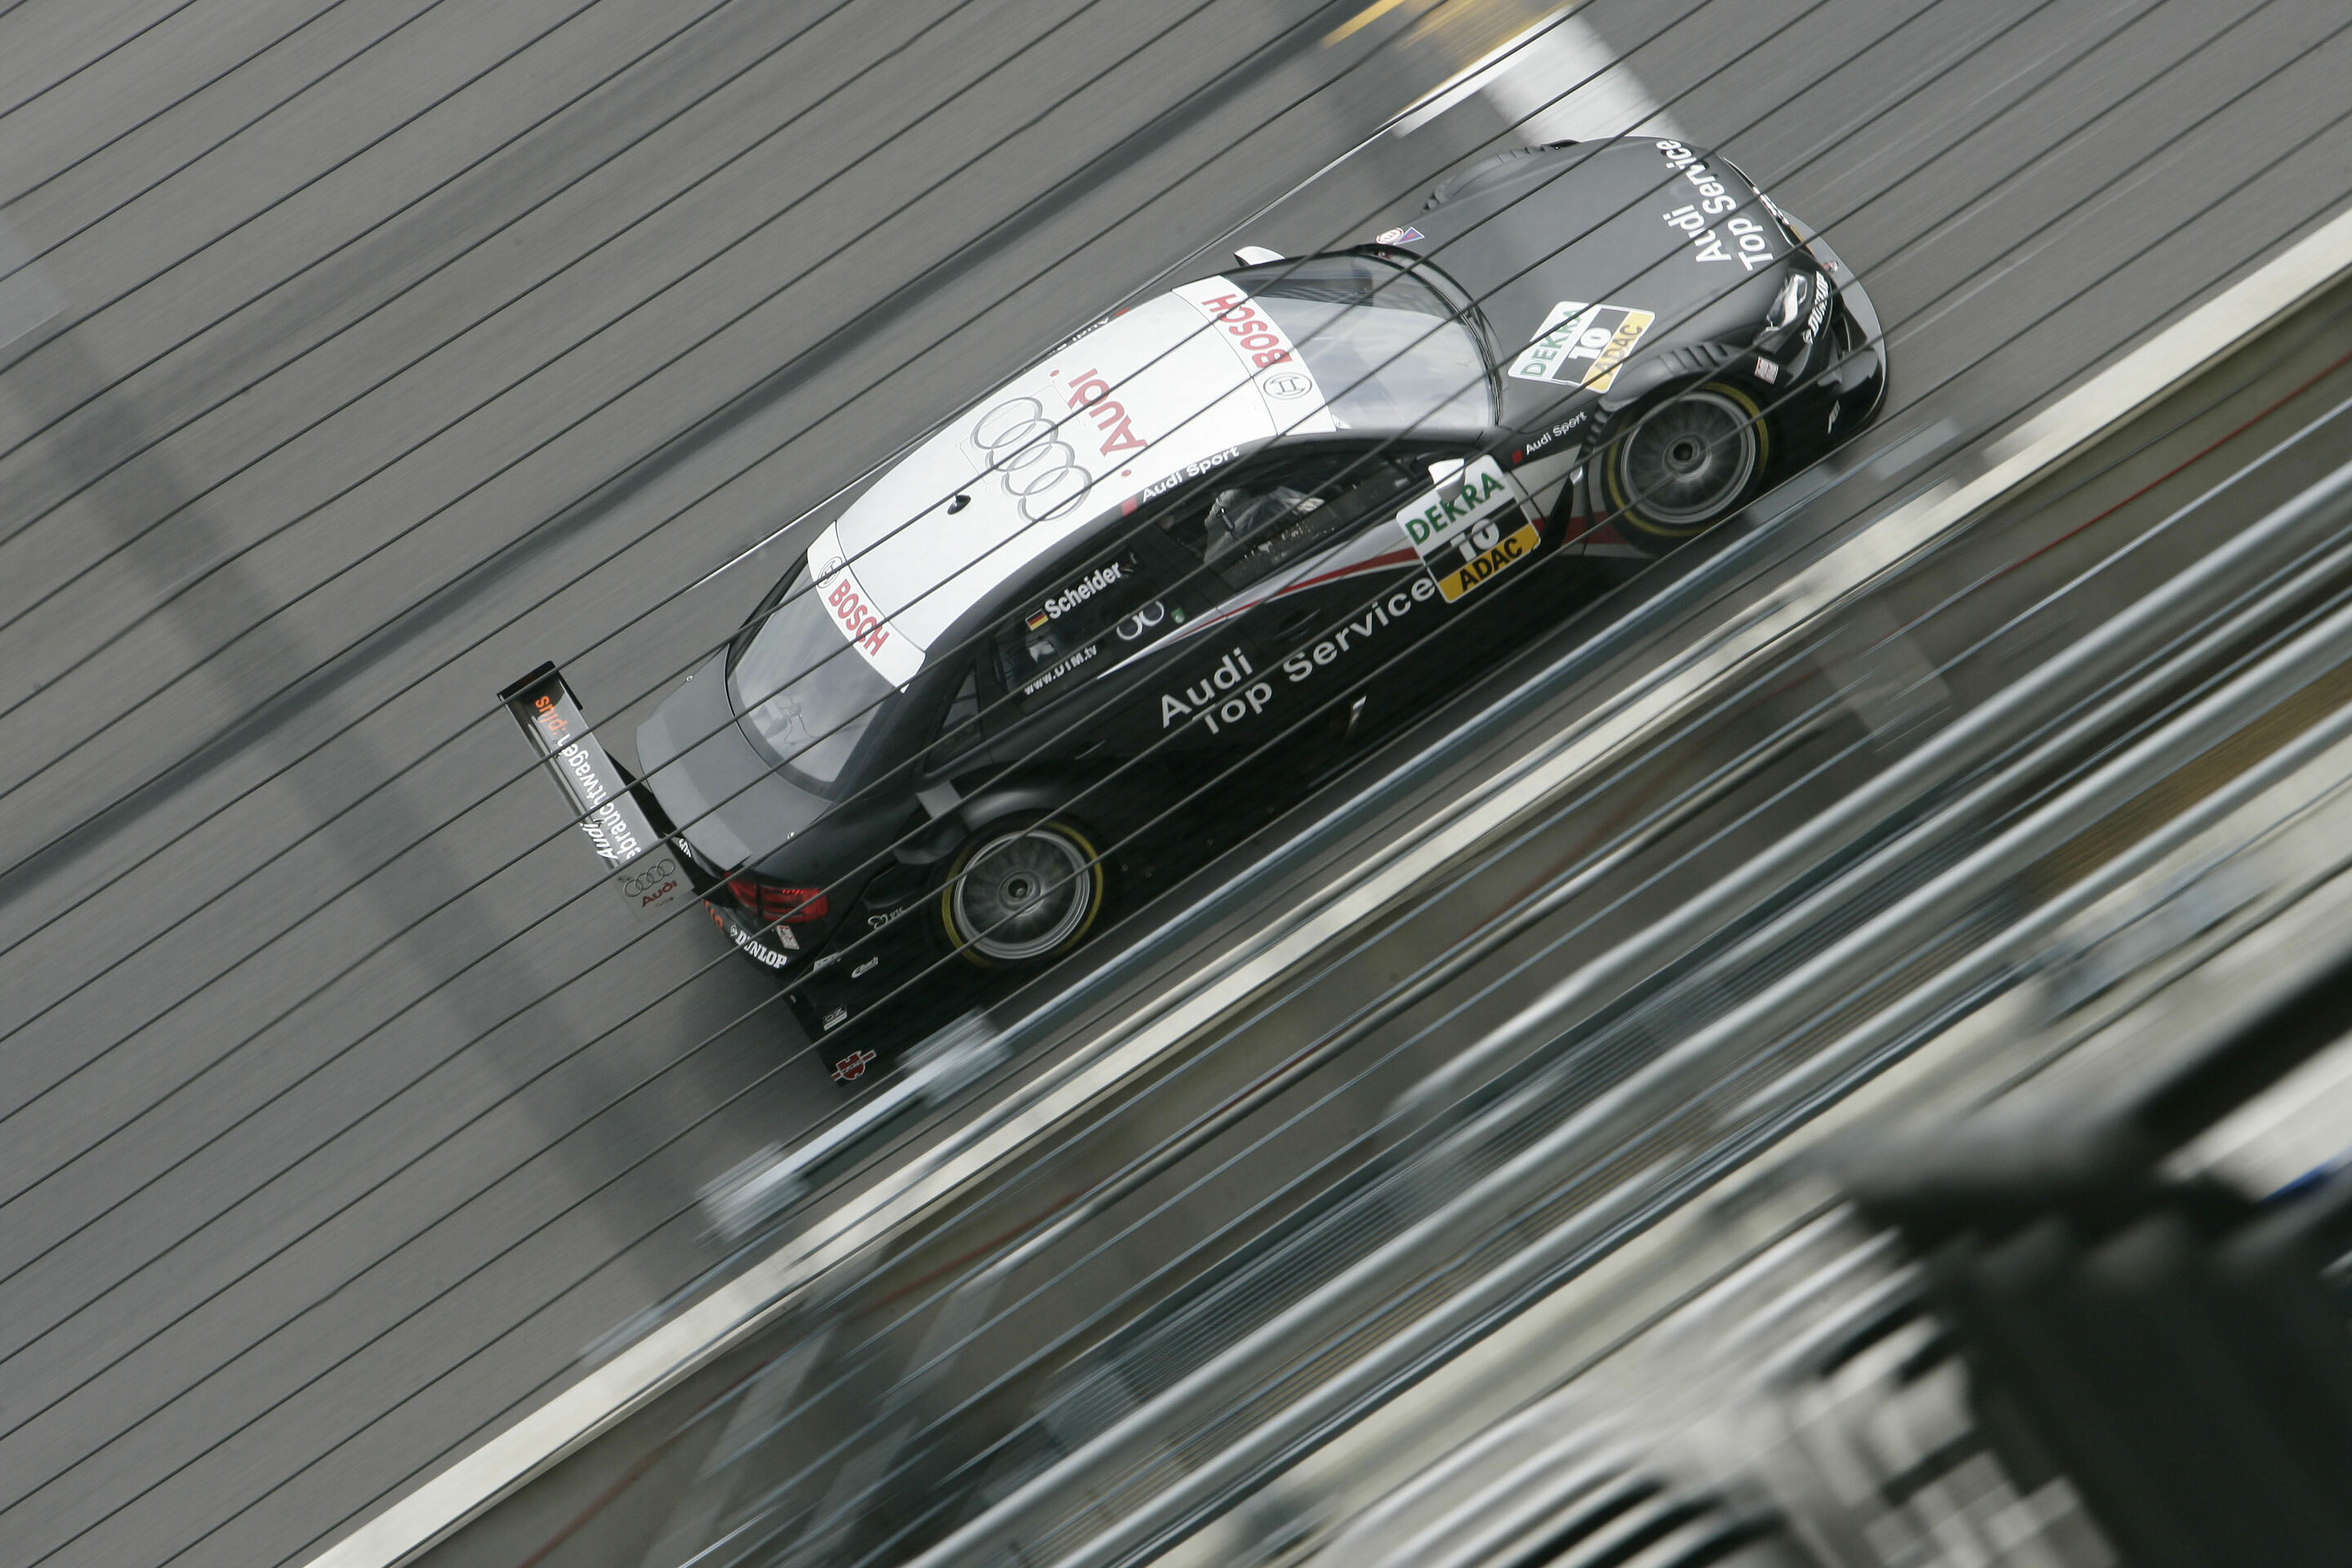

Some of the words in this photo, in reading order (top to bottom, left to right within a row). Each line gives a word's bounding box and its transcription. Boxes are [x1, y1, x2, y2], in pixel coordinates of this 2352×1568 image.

[1655, 139, 1737, 216] Service
[1663, 204, 1732, 262] Audi
[1727, 216, 1775, 271] Top
[1200, 293, 1293, 369] BOSCH
[1568, 327, 1612, 359] 10
[1593, 324, 1642, 378] ADAC
[1067, 368, 1148, 457] Audi
[1526, 431, 1552, 456] Audi
[1552, 411, 1588, 438] Sport
[1143, 470, 1183, 503] Audi
[1186, 446, 1241, 478] Sport
[1405, 472, 1505, 546] DEKRA
[1450, 518, 1499, 563] 10
[1459, 537, 1523, 592] ADAC
[828, 578, 889, 657] BOSCH
[1045, 562, 1122, 619] Scheider
[1192, 681, 1272, 735] Top
[1282, 577, 1436, 683] Service
[1160, 646, 1254, 729] Audi
[580, 822, 619, 861] Audi
[642, 880, 678, 908] Audi
[735, 929, 788, 969] DUNLOP
